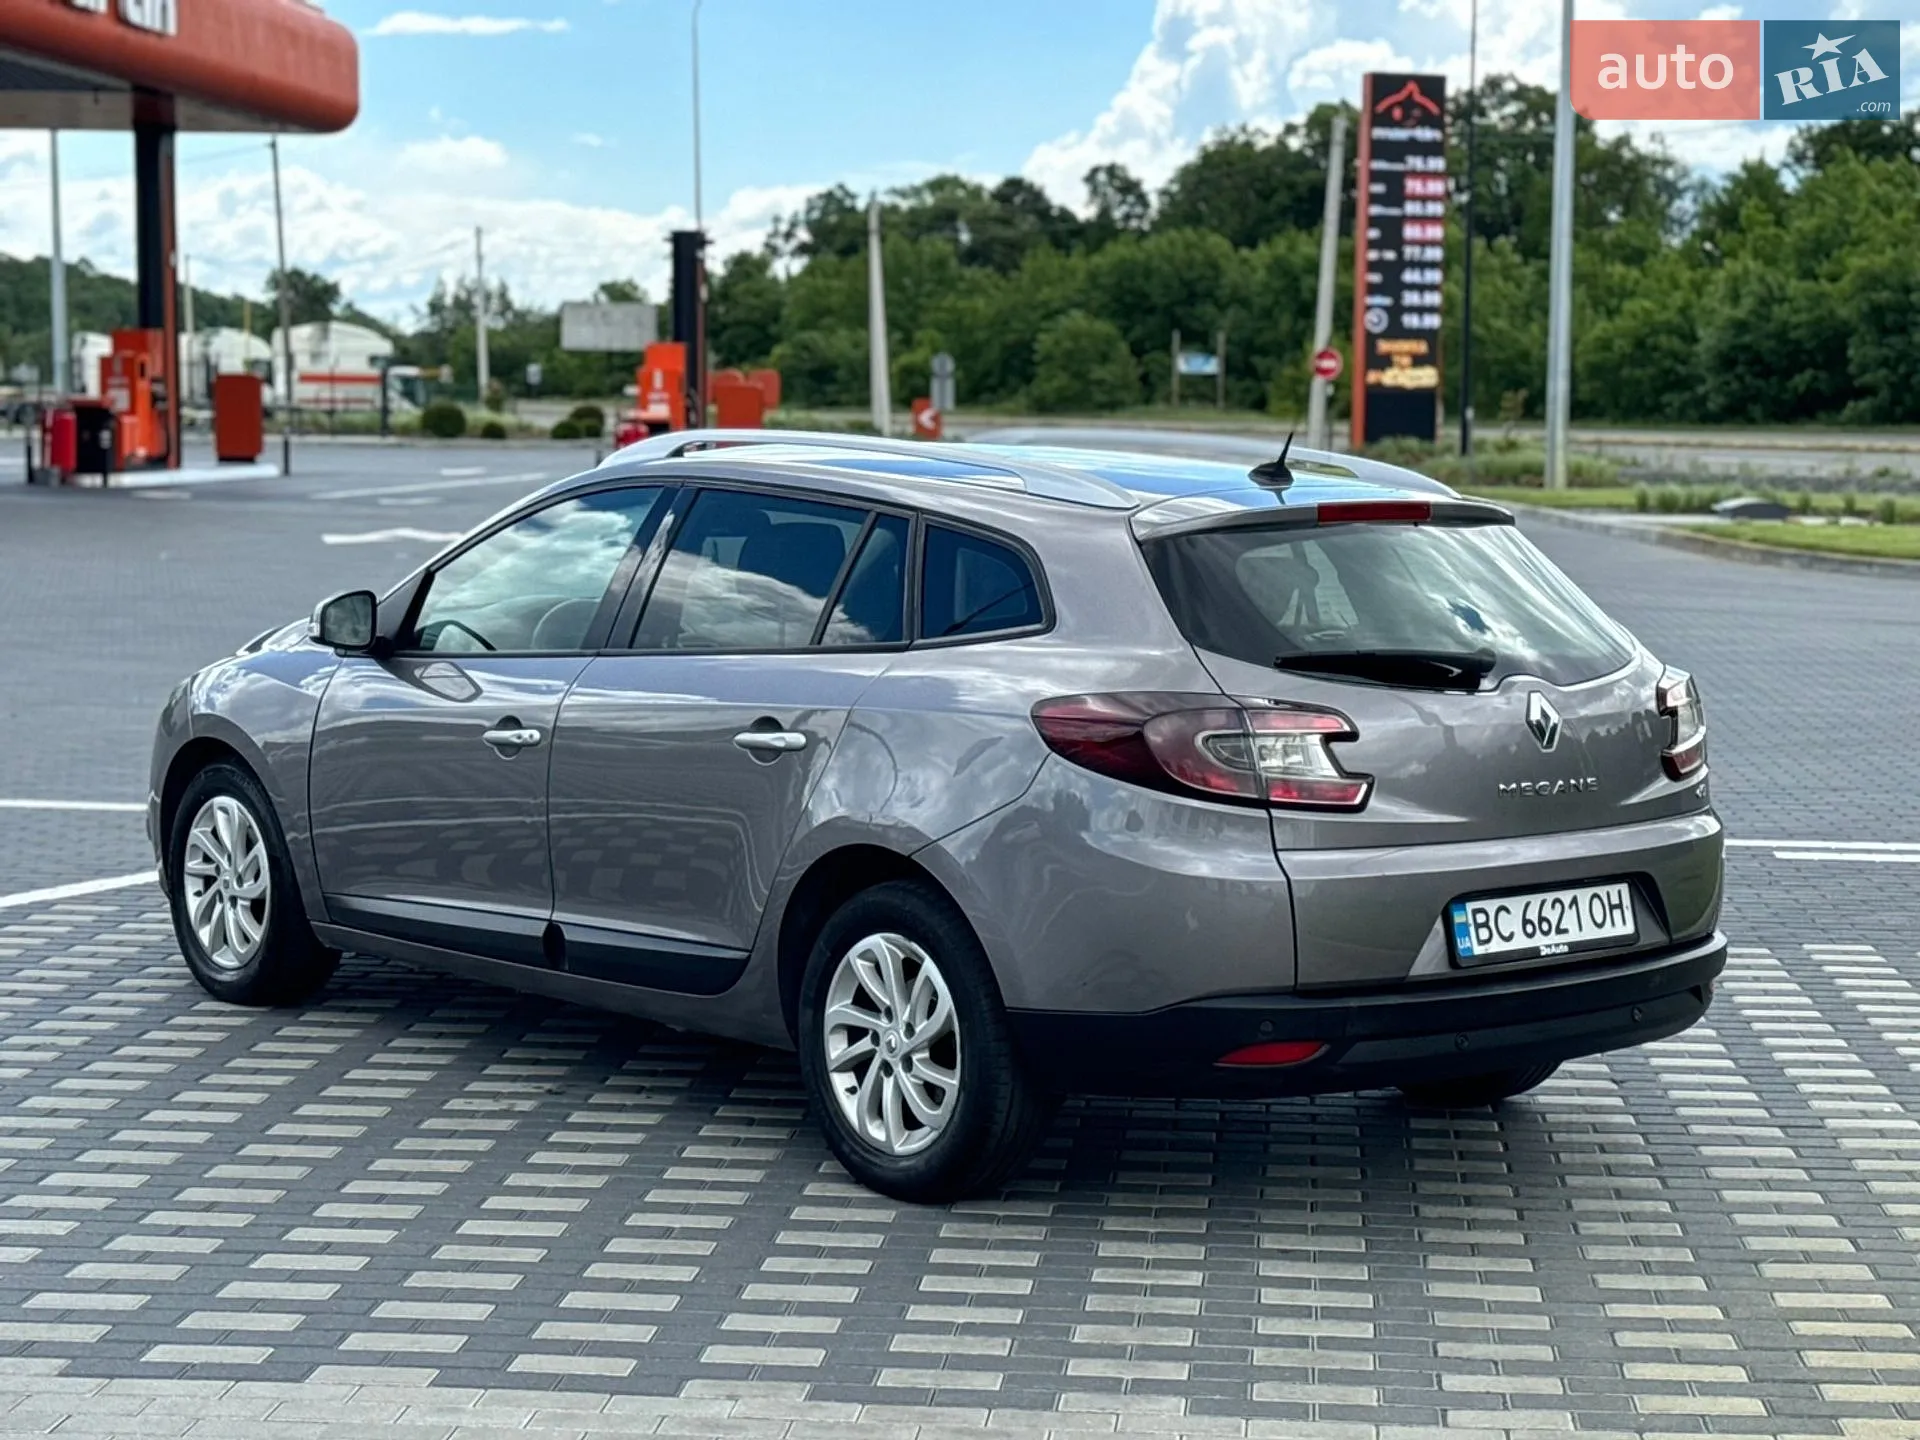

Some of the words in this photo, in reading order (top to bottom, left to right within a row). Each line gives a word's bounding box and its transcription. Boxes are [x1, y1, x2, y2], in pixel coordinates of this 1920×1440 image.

[1498, 777, 1599, 798] MEGANE
[1471, 904, 1515, 947] BC
[1521, 894, 1583, 940] 6621
[1588, 888, 1627, 930] OH
[1457, 937, 1471, 950] UA
